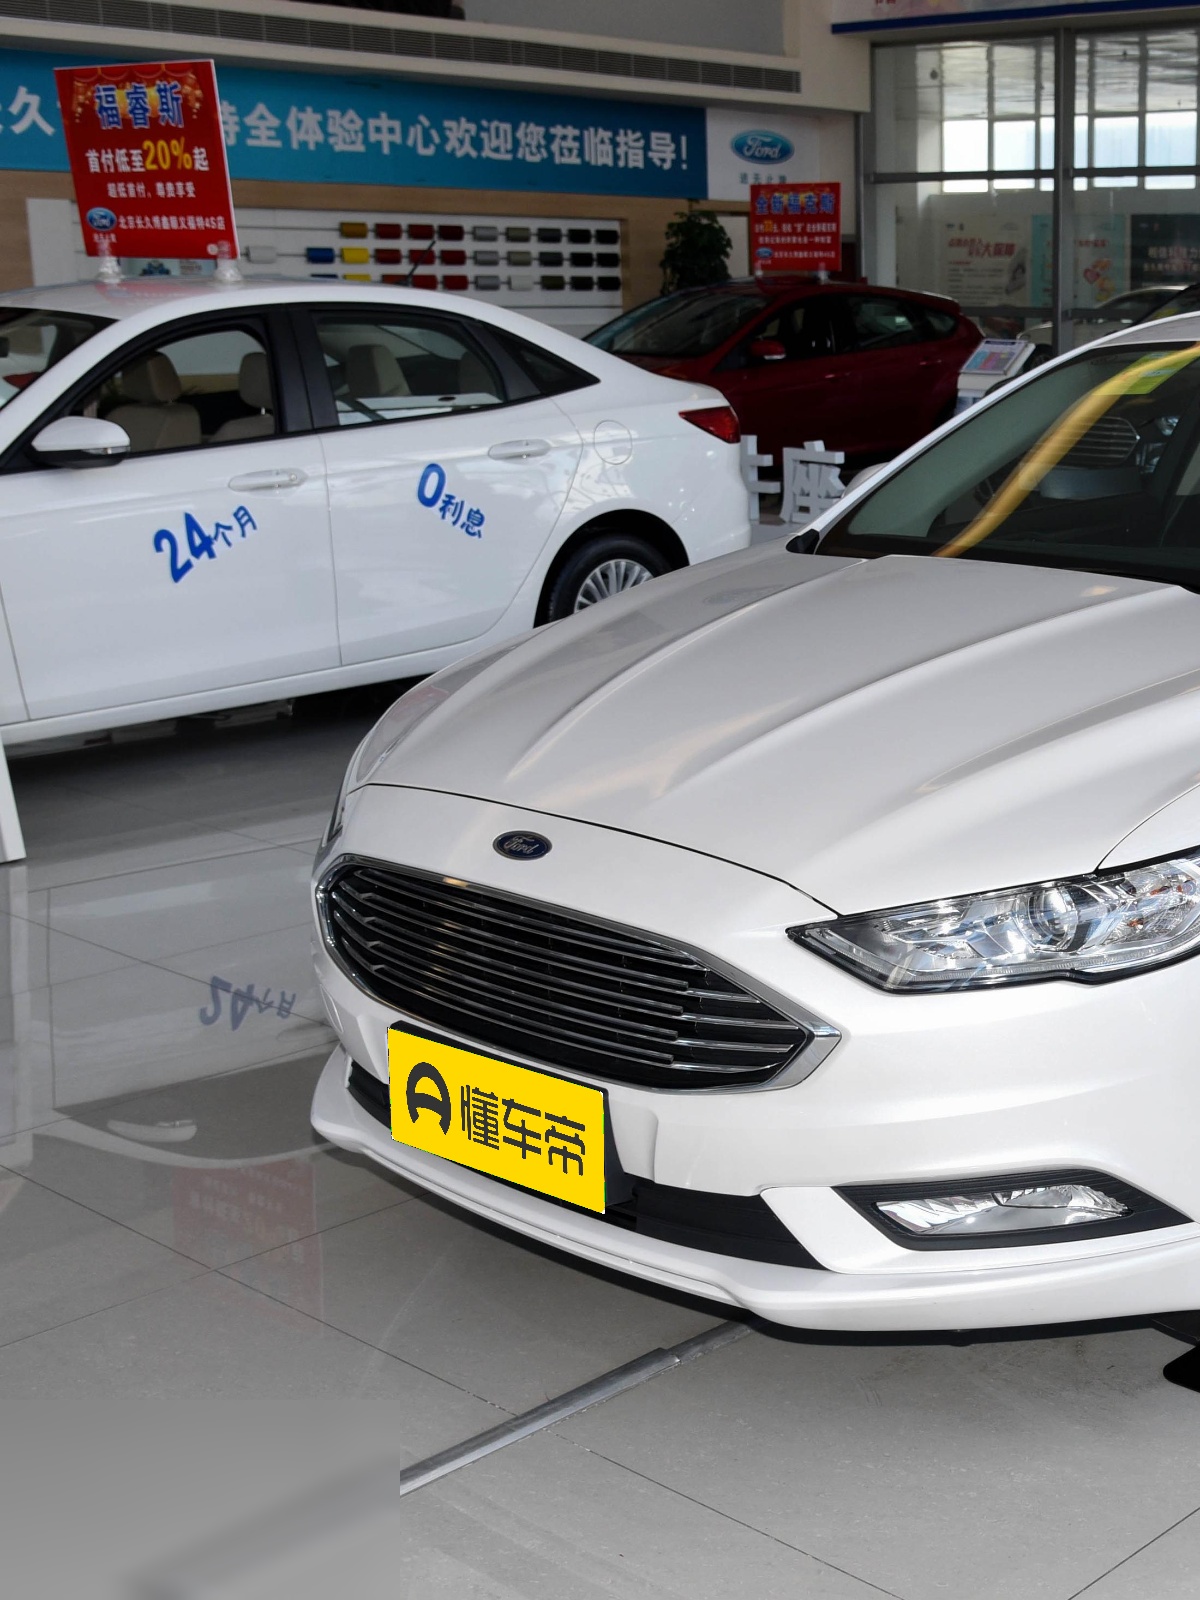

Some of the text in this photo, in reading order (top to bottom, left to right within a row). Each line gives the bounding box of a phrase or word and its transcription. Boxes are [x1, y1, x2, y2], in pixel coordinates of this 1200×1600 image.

[94, 80, 185, 130] 福睿斯
[85, 136, 209, 173] 首付低至20%起
[417, 463, 487, 539] 0利息
[154, 505, 258, 583] 24个月
[503, 835, 540, 855] Ford
